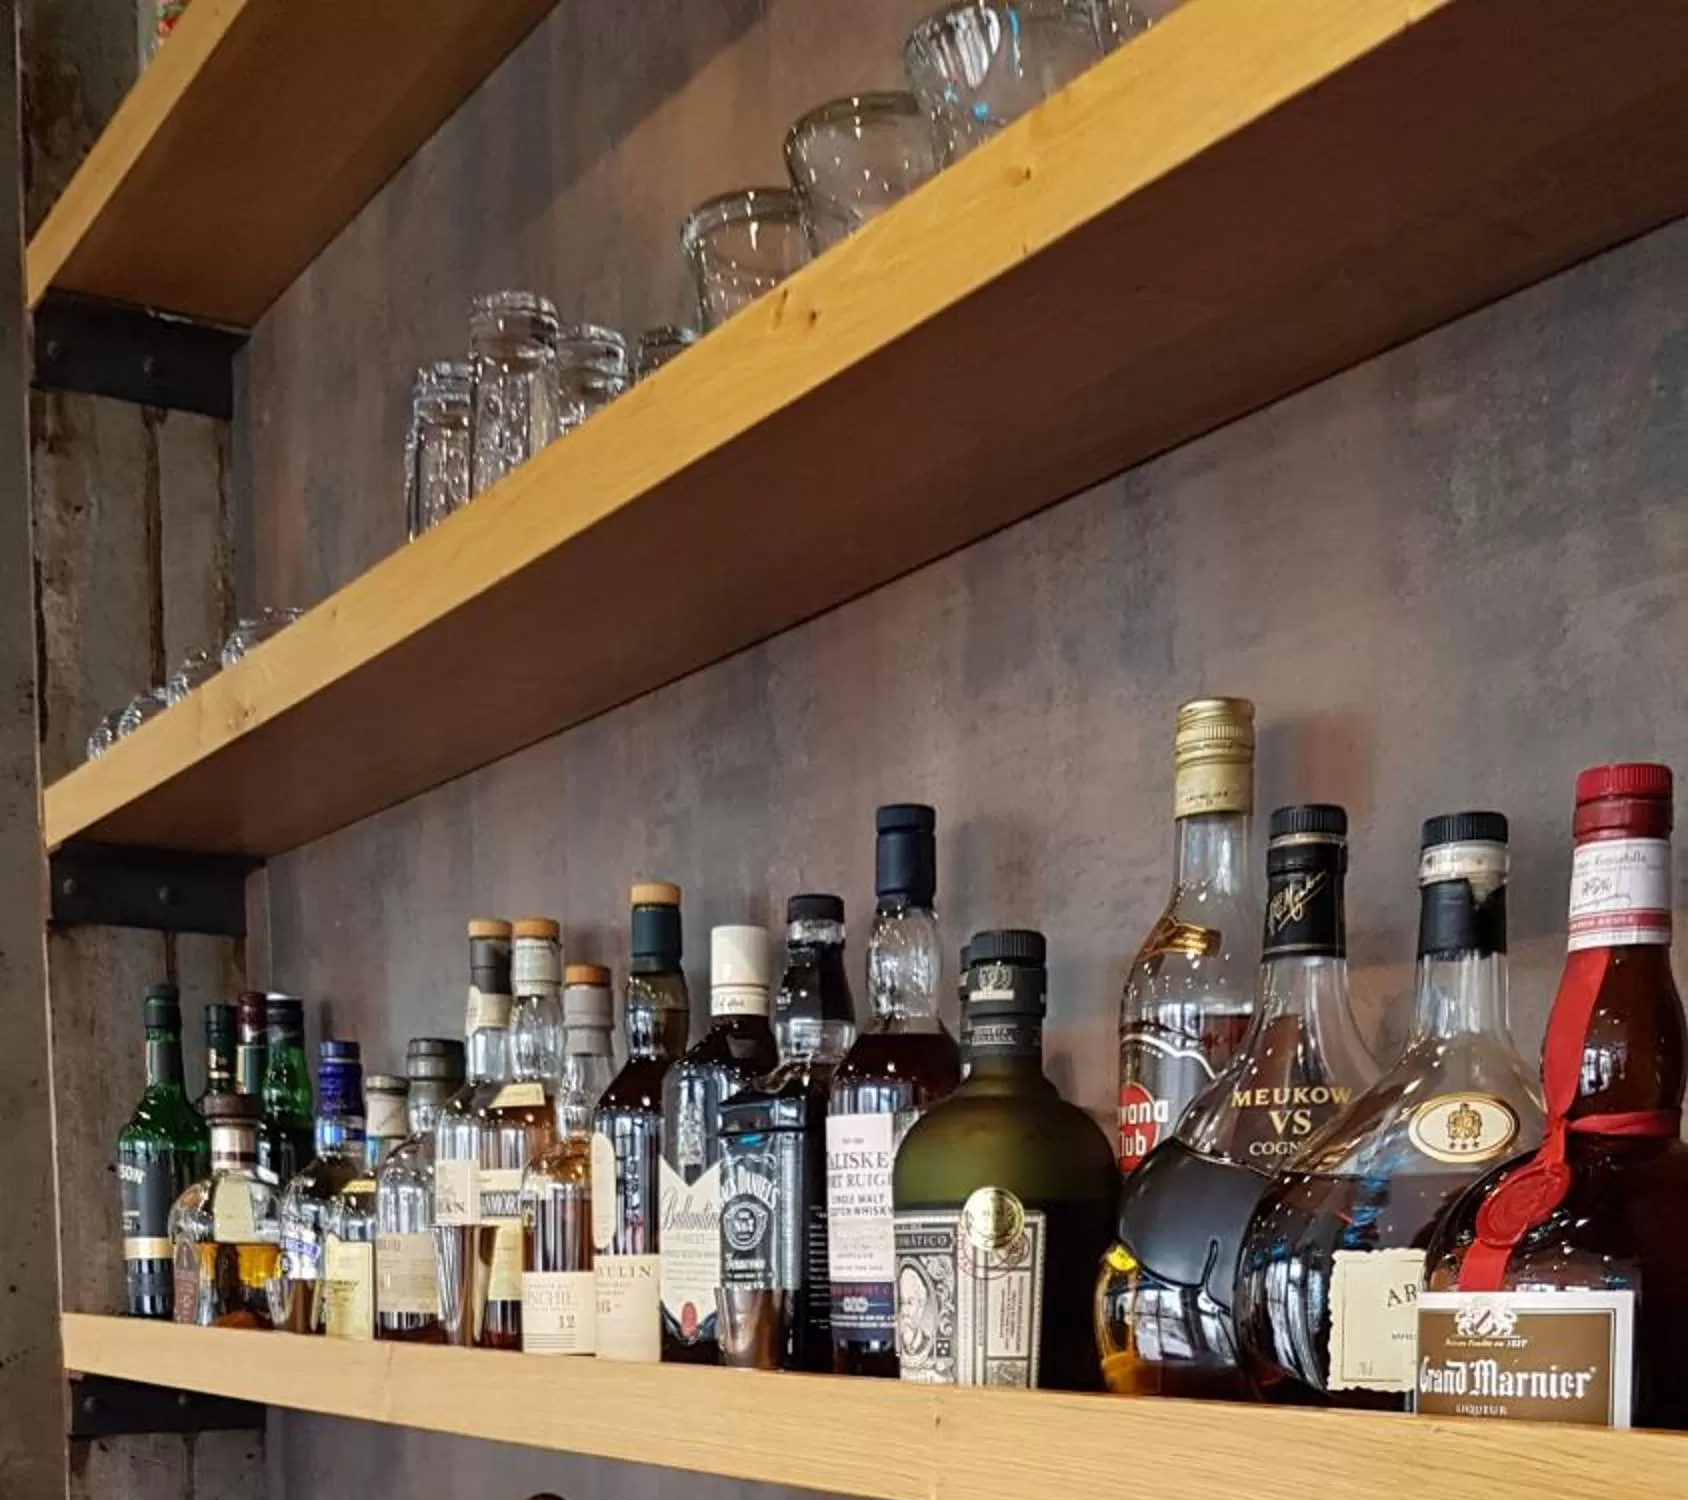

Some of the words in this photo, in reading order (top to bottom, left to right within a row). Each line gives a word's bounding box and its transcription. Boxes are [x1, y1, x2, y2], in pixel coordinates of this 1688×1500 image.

[1231, 1087, 1352, 1108] MEUKOW
[1269, 1109, 1312, 1135] VS
[1249, 1141, 1312, 1156] COGN
[560, 1315, 576, 1329] 12
[1419, 1356, 1468, 1395] Grand
[1468, 1358, 1594, 1399] Marnier
